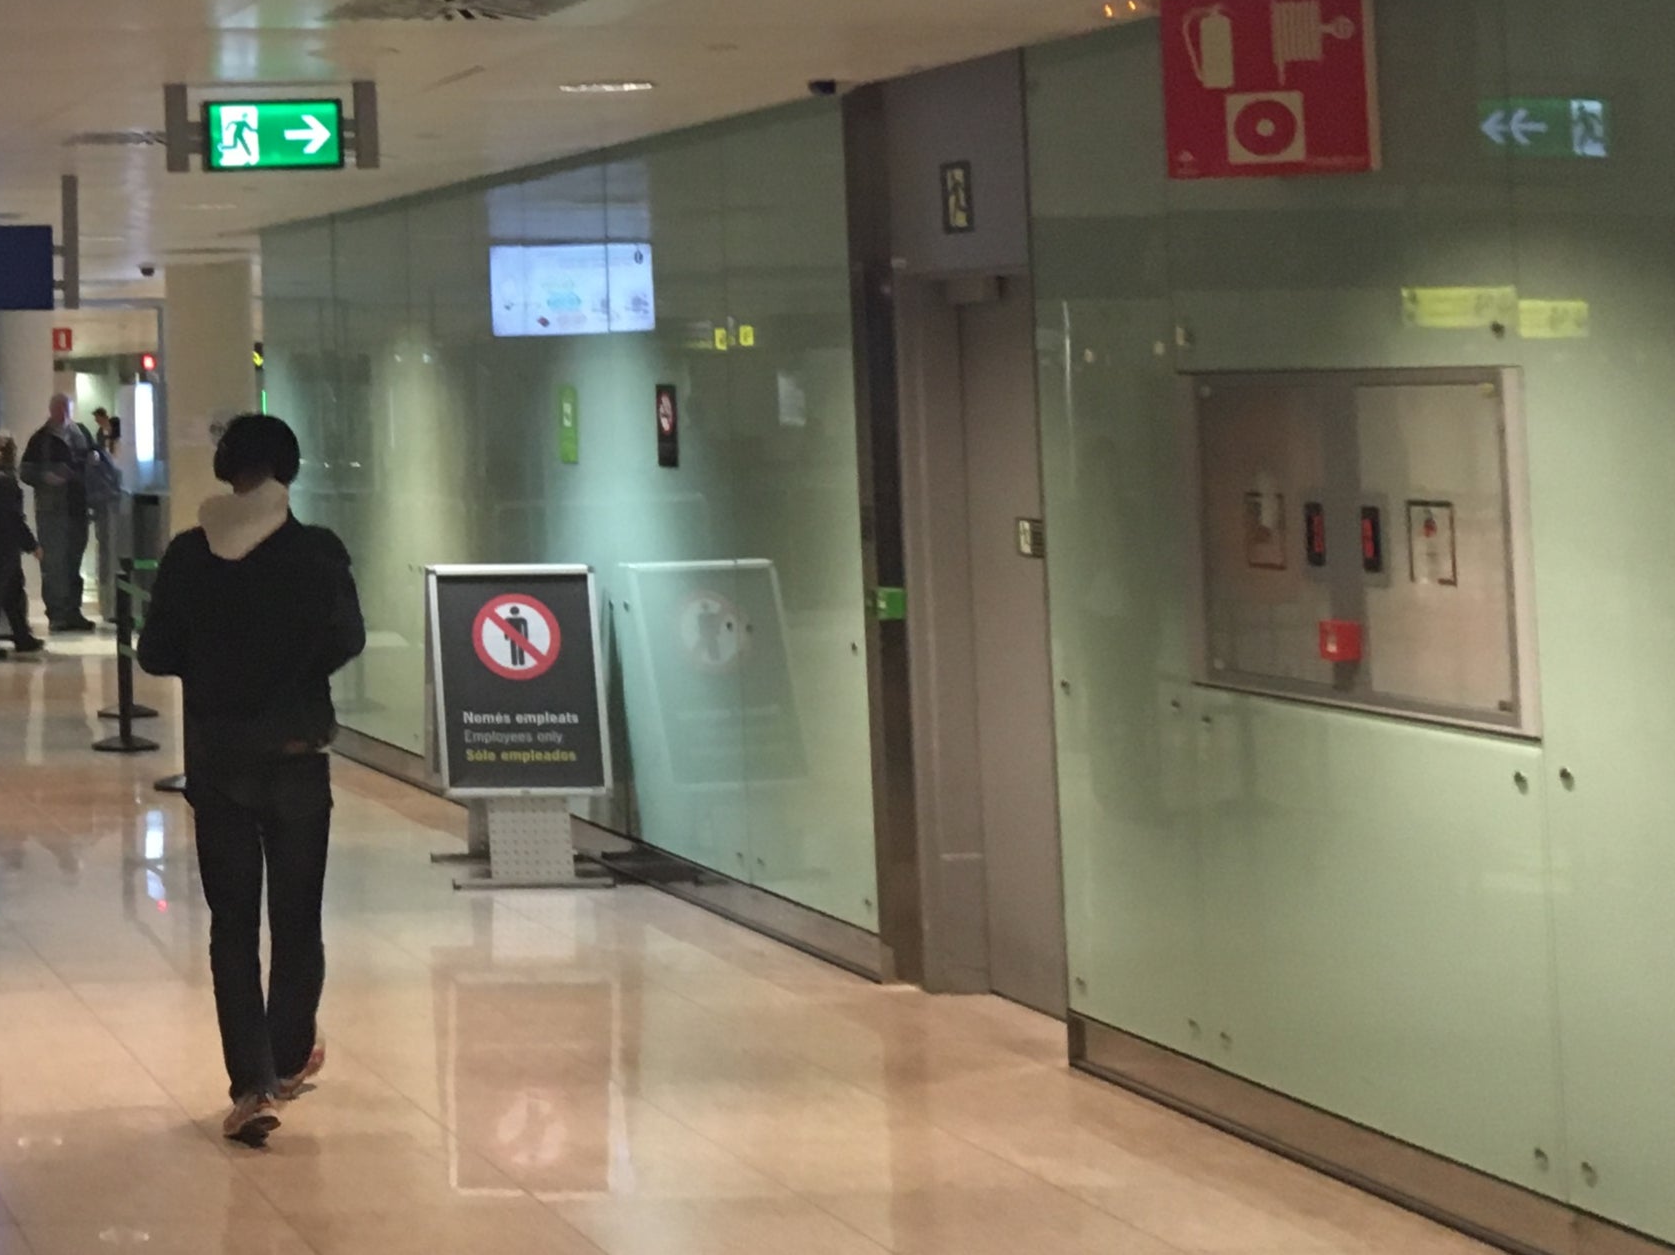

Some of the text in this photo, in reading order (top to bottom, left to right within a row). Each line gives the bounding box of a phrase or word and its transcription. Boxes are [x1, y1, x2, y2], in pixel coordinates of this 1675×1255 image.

[463, 711, 579, 726] Només empleats
[464, 729, 563, 745] Employees only
[500, 749, 577, 764] empleados
